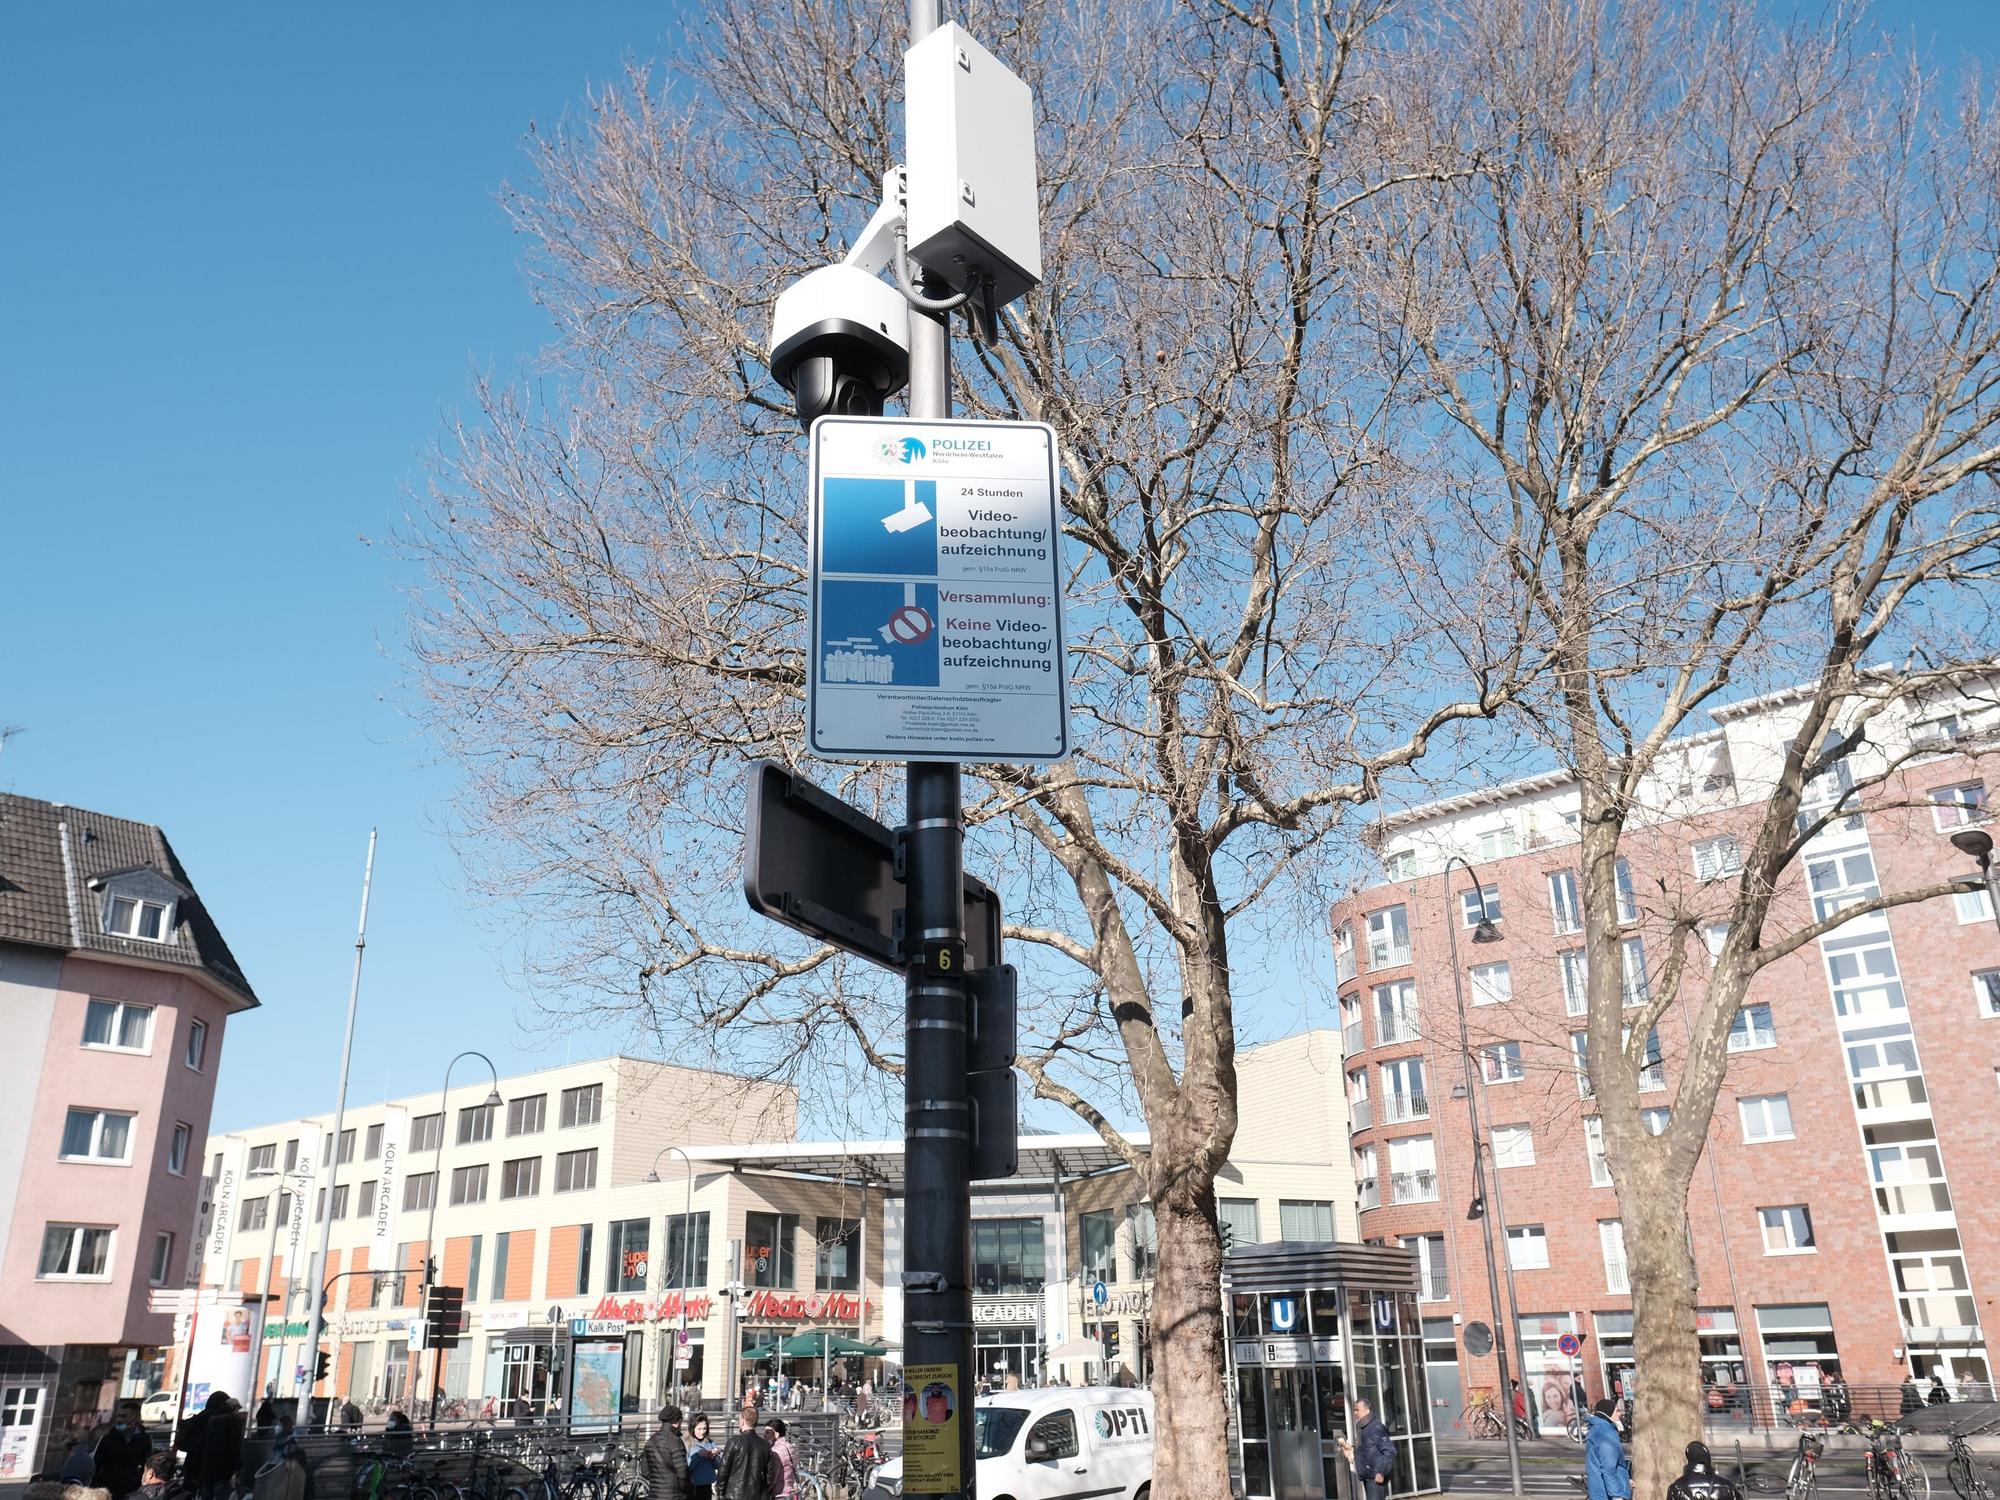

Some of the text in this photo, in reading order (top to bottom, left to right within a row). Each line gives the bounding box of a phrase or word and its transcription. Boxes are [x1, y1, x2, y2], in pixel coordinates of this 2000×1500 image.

[932, 439, 991, 451] POLIZEI
[961, 488, 1023, 498] 24 Stunden
[968, 509, 1018, 522] Video-
[940, 526, 1047, 543] beobachtung/
[941, 544, 1047, 560] aufzeichnung
[939, 591, 1051, 608] Versammlung:
[946, 618, 1047, 632] Keine Video-
[942, 636, 1052, 654] beobachtung/
[943, 655, 1052, 672] aufzeichnung
[939, 948, 952, 971] 6
[376, 1176, 392, 1237] ARCADEN
[213, 1200, 229, 1255] ARCADEN
[746, 1290, 807, 1318] Media
[972, 1304, 1037, 1321] RCADEN
[1273, 1300, 1296, 1329] U
[1377, 1299, 1392, 1327] U
[573, 1320, 625, 1334] U Kalk Post
[1095, 1408, 1149, 1439] OPTI
